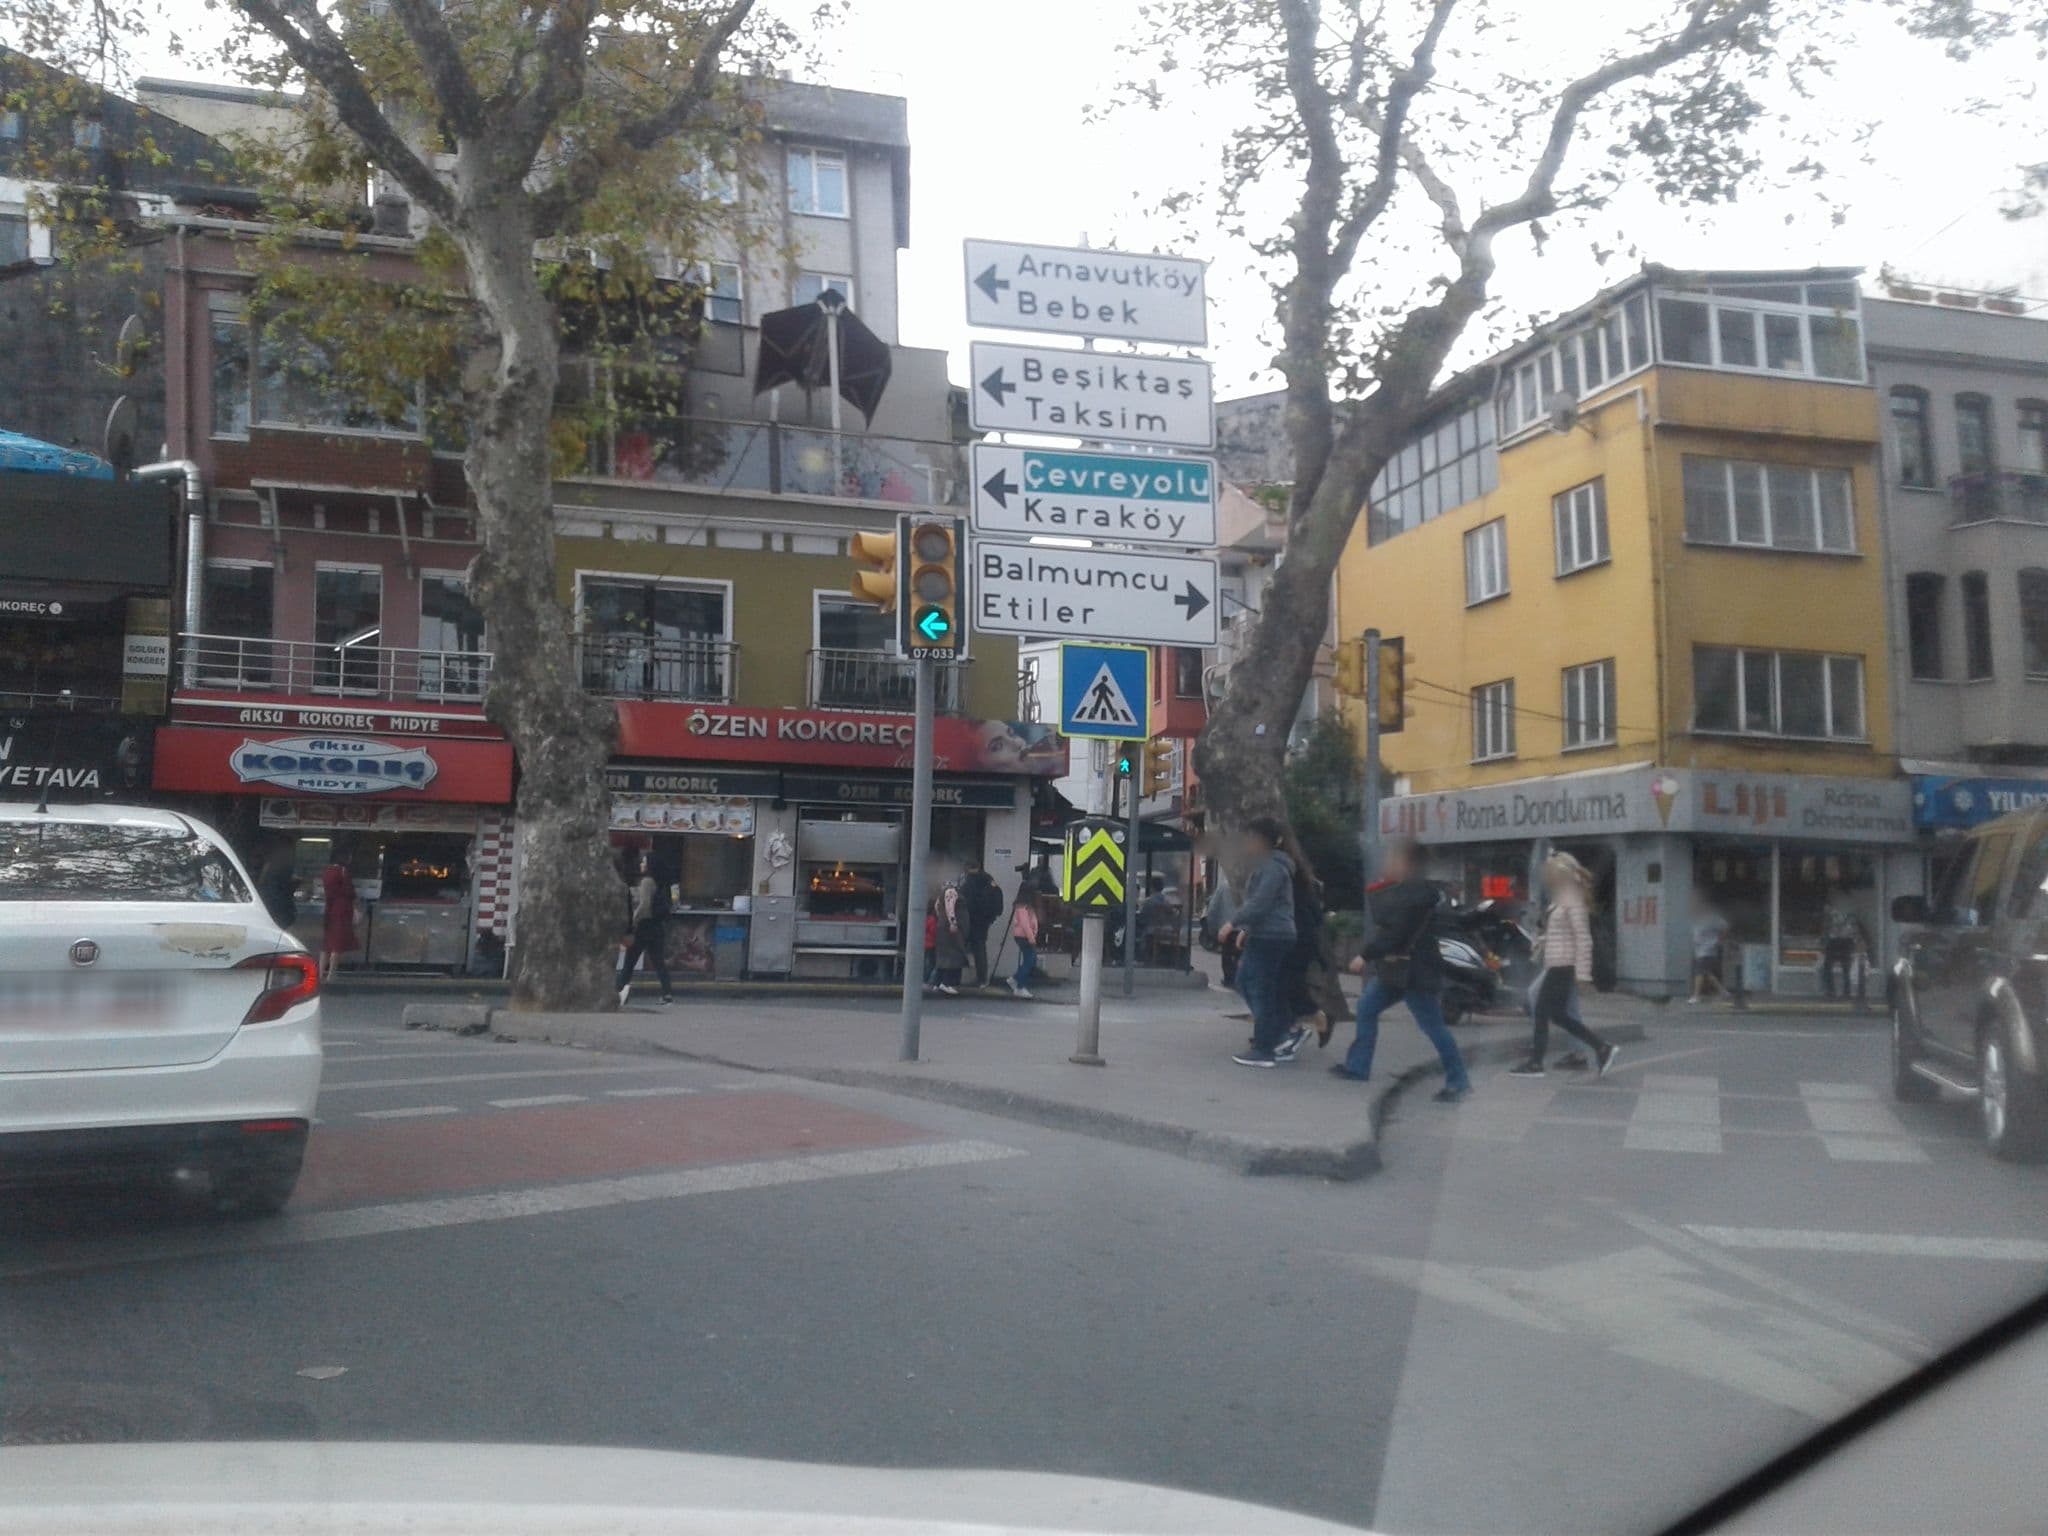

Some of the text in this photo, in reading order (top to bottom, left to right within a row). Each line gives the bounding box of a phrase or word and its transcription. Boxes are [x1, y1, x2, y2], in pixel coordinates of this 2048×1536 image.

[1018, 254, 1198, 297] Arnavutköy
[1018, 290, 1139, 326] Bebek
[1023, 357, 1194, 400] Beşiktaş
[1025, 396, 1167, 433] Taksim
[1025, 458, 1209, 498] Çevreyolu
[1024, 497, 1186, 539] Karaköy
[983, 554, 1169, 592] Balmumcu
[983, 593, 1096, 625] Etiler
[912, 647, 955, 660] 07-033
[240, 709, 284, 724] AKSU
[298, 711, 375, 731] KOKOREÇ
[687, 708, 914, 749] ÖZEN KOKOREÇ
[242, 753, 425, 782] KOKOREÇ
[1456, 800, 1507, 830] Roma
[1513, 788, 1628, 827] Dondurma
